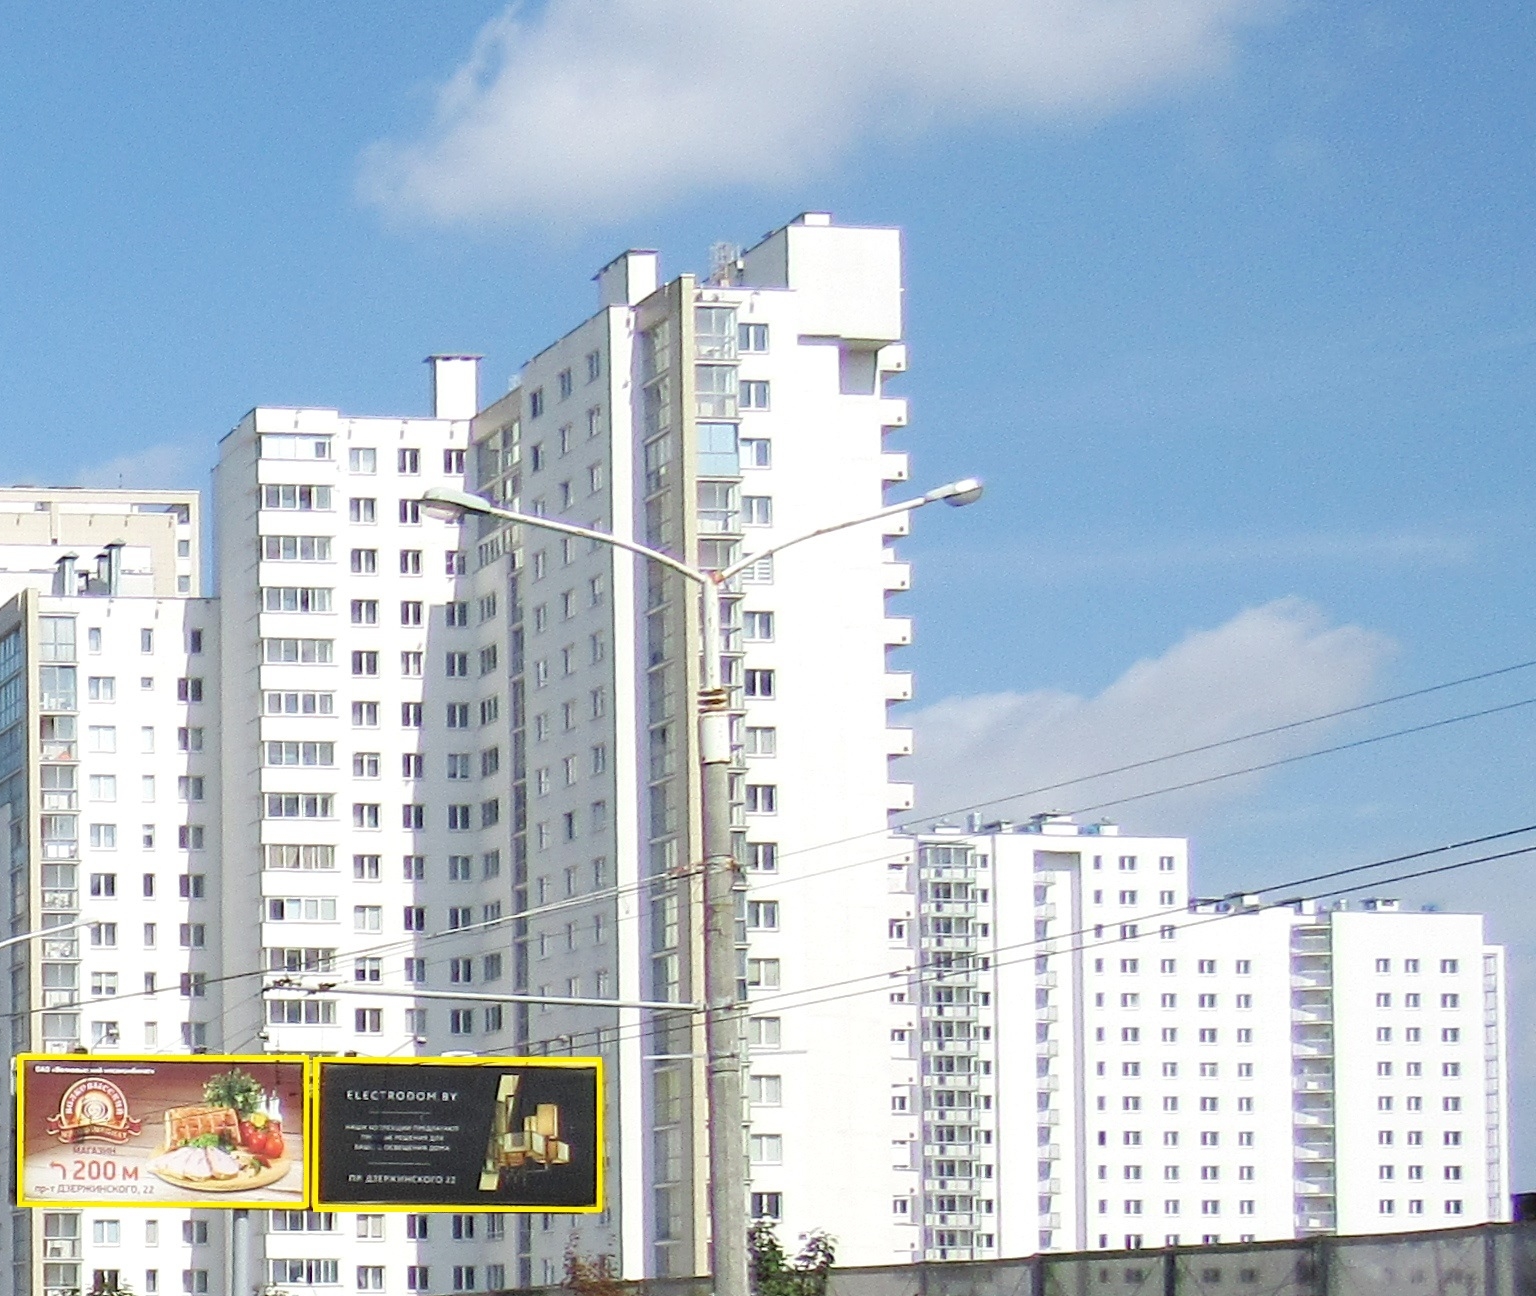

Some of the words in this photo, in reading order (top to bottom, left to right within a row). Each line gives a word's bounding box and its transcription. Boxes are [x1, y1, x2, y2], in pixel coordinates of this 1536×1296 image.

[73, 1146, 116, 1155] МАГАЗИН
[73, 1160, 116, 1180] 200
[143, 1185, 154, 1194] 22
